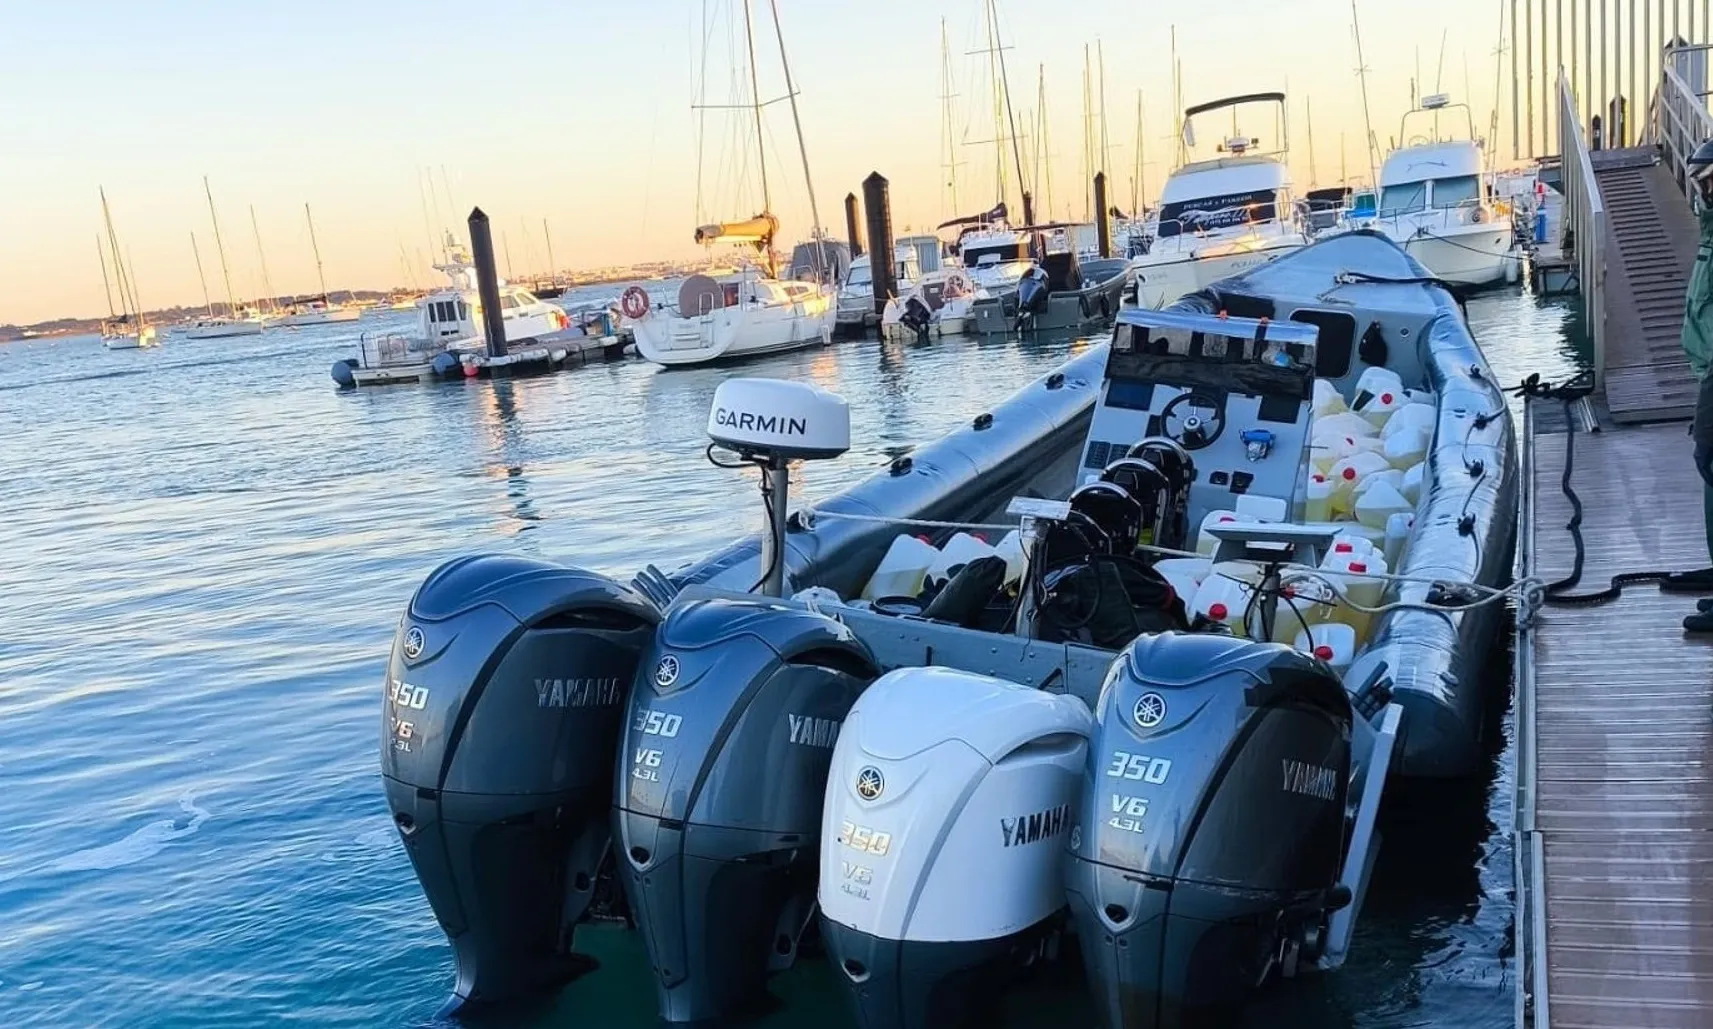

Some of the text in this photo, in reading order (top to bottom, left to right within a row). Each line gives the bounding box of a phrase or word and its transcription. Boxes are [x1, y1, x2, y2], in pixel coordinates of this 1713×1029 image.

[716, 407, 806, 435] GARMIN
[533, 678, 620, 707] YAMAHA
[633, 708, 683, 738] 350
[788, 713, 844, 748] YAMA
[634, 747, 664, 768] V6
[1106, 751, 1172, 785] 350
[1112, 793, 1150, 817] V6
[839, 820, 892, 856] 350
[1000, 804, 1071, 847] YAMAHA
[842, 860, 873, 885] V6
